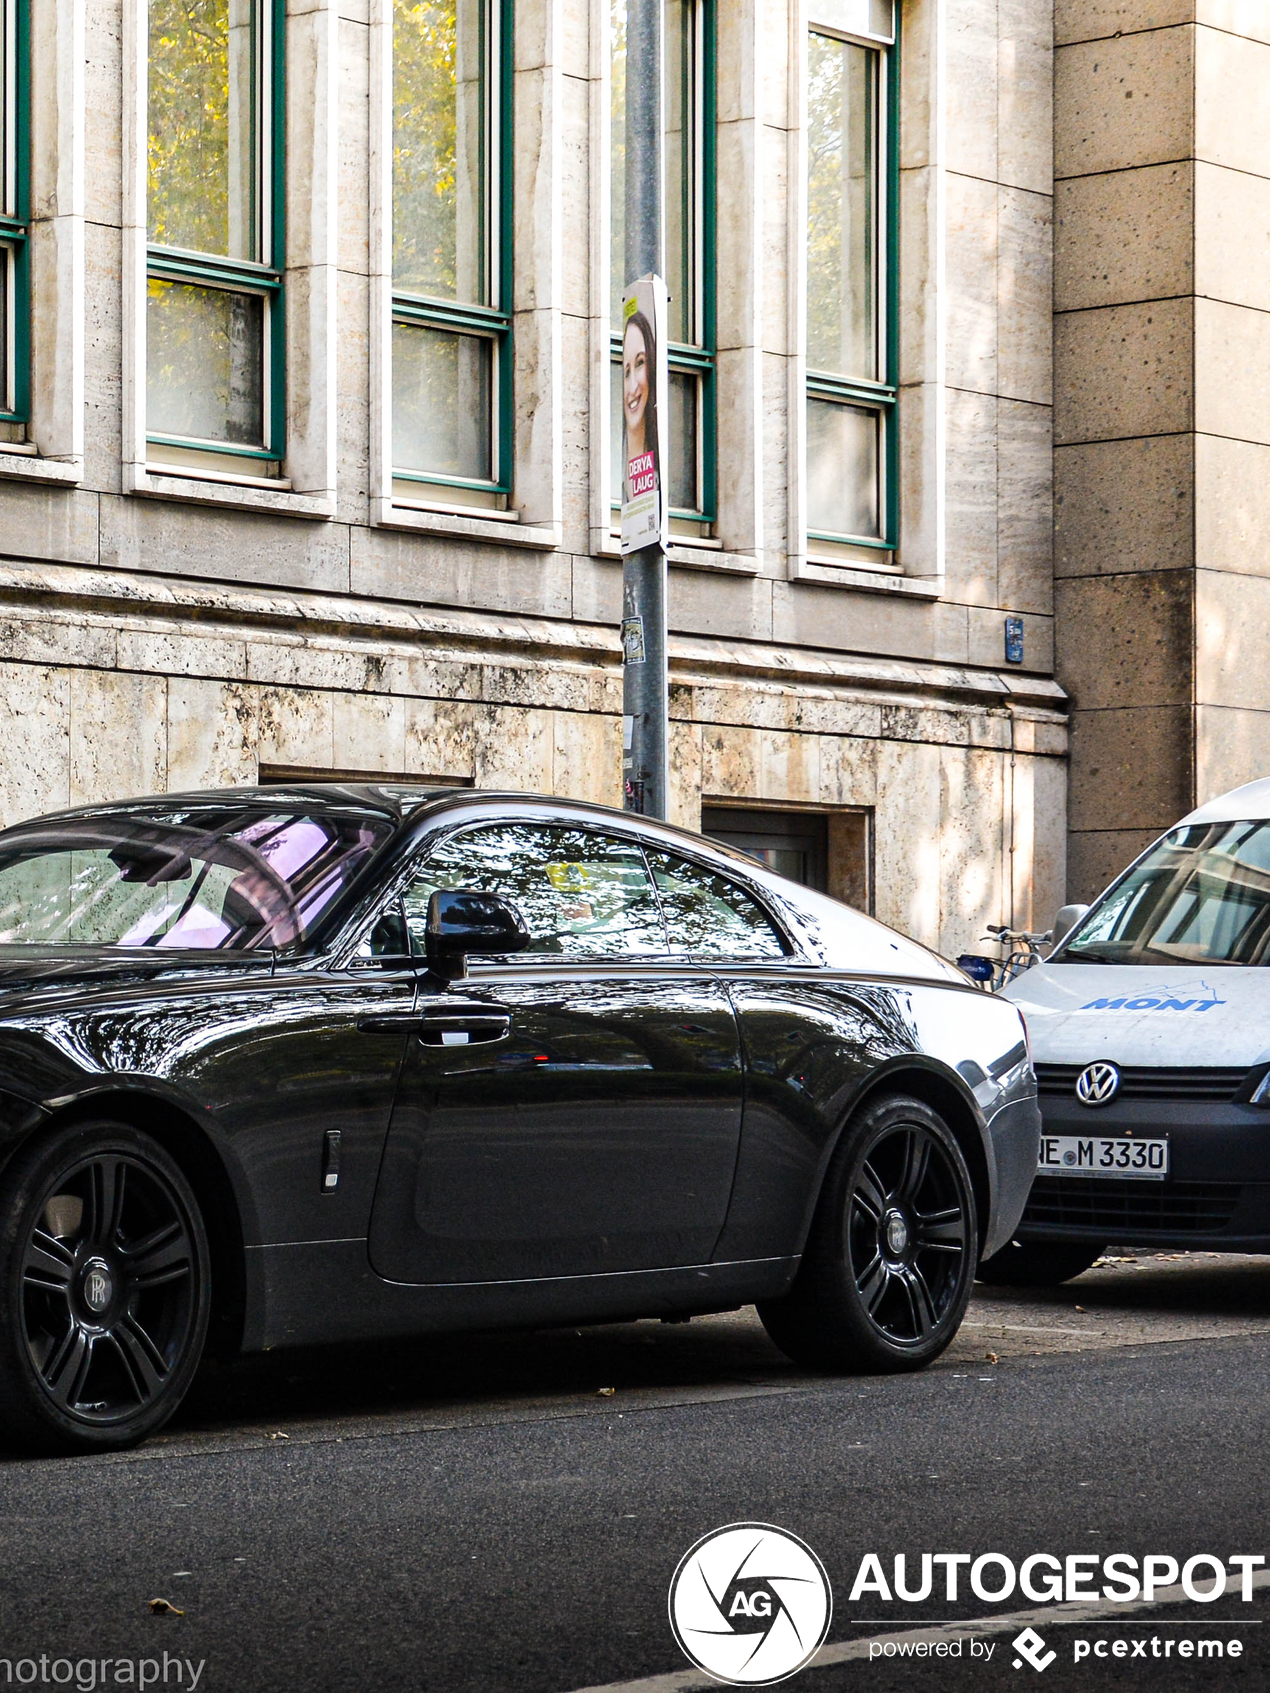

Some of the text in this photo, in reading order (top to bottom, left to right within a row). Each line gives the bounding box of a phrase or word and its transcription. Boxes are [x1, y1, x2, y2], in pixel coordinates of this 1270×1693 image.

[629, 455, 653, 477] DERYA
[633, 473, 653, 493] LAUG
[1080, 998, 1227, 1011] MONT
[1078, 1141, 1093, 1166] M
[1099, 1141, 1164, 1169] 3330
